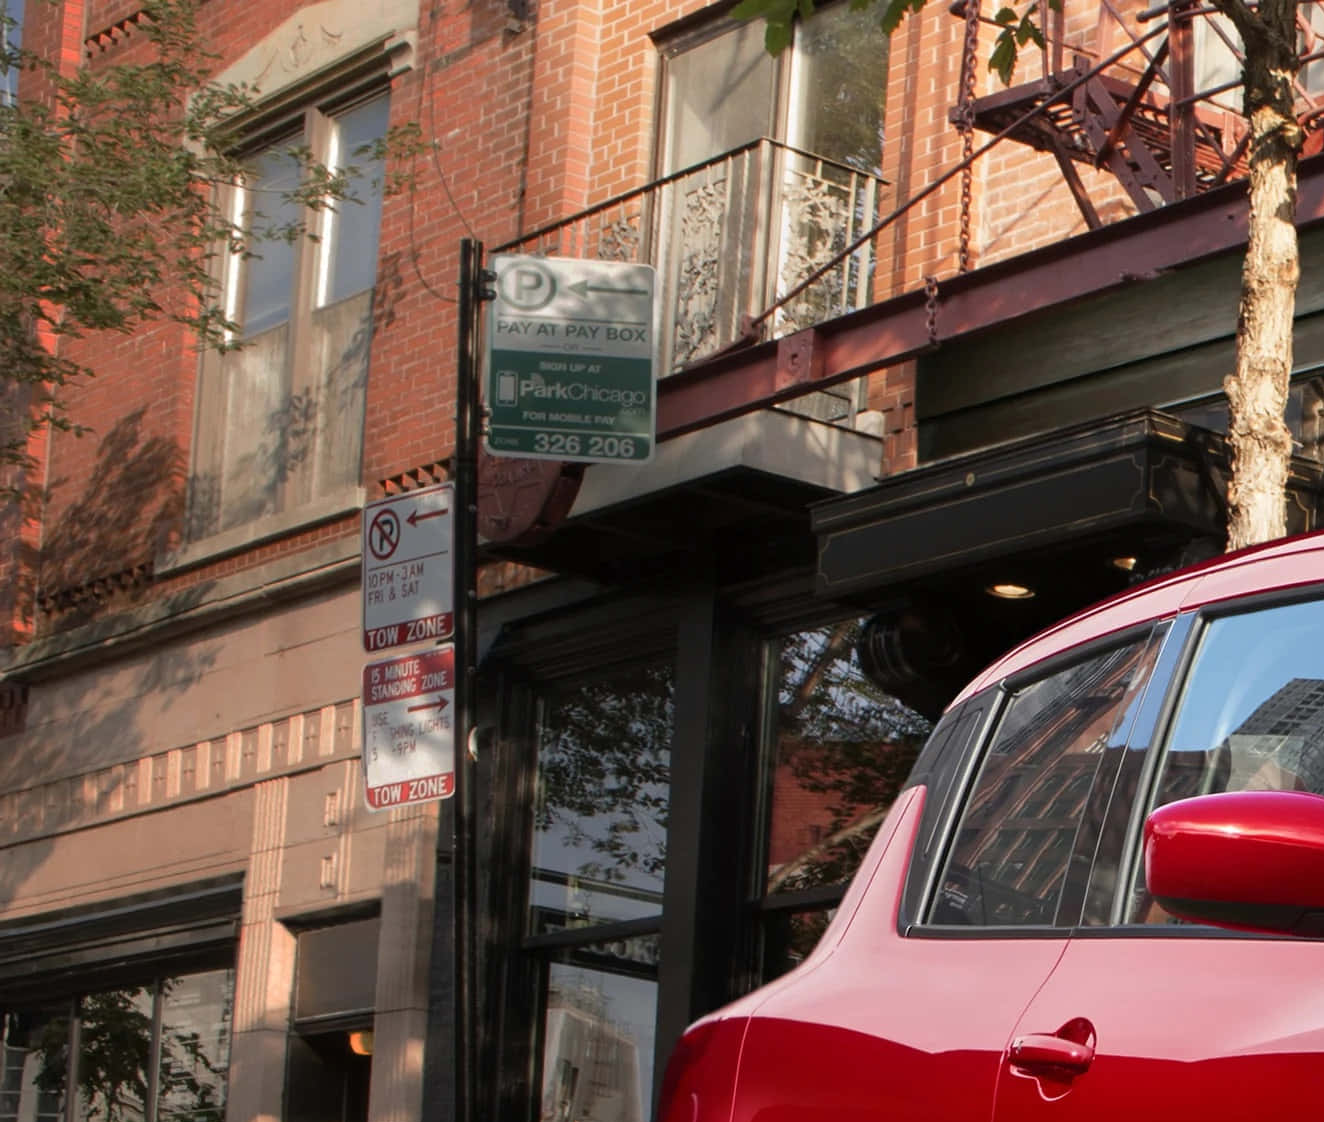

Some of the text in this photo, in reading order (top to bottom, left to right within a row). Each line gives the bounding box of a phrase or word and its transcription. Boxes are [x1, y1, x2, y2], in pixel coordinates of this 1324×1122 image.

[497, 319, 647, 343] PAY AT PAY BOX
[539, 360, 602, 374] SIGN UP AT
[520, 378, 646, 407] ParkChicago
[522, 411, 617, 426] FOR MOBILE PAY
[534, 433, 581, 455] 326
[589, 436, 635, 458] 206
[401, 580, 419, 598] SAT
[368, 615, 446, 649] TOW ZONE
[385, 659, 420, 680] MINUTE
[371, 670, 447, 701] STANDING ZONE
[373, 775, 448, 805] TOW ZONE
